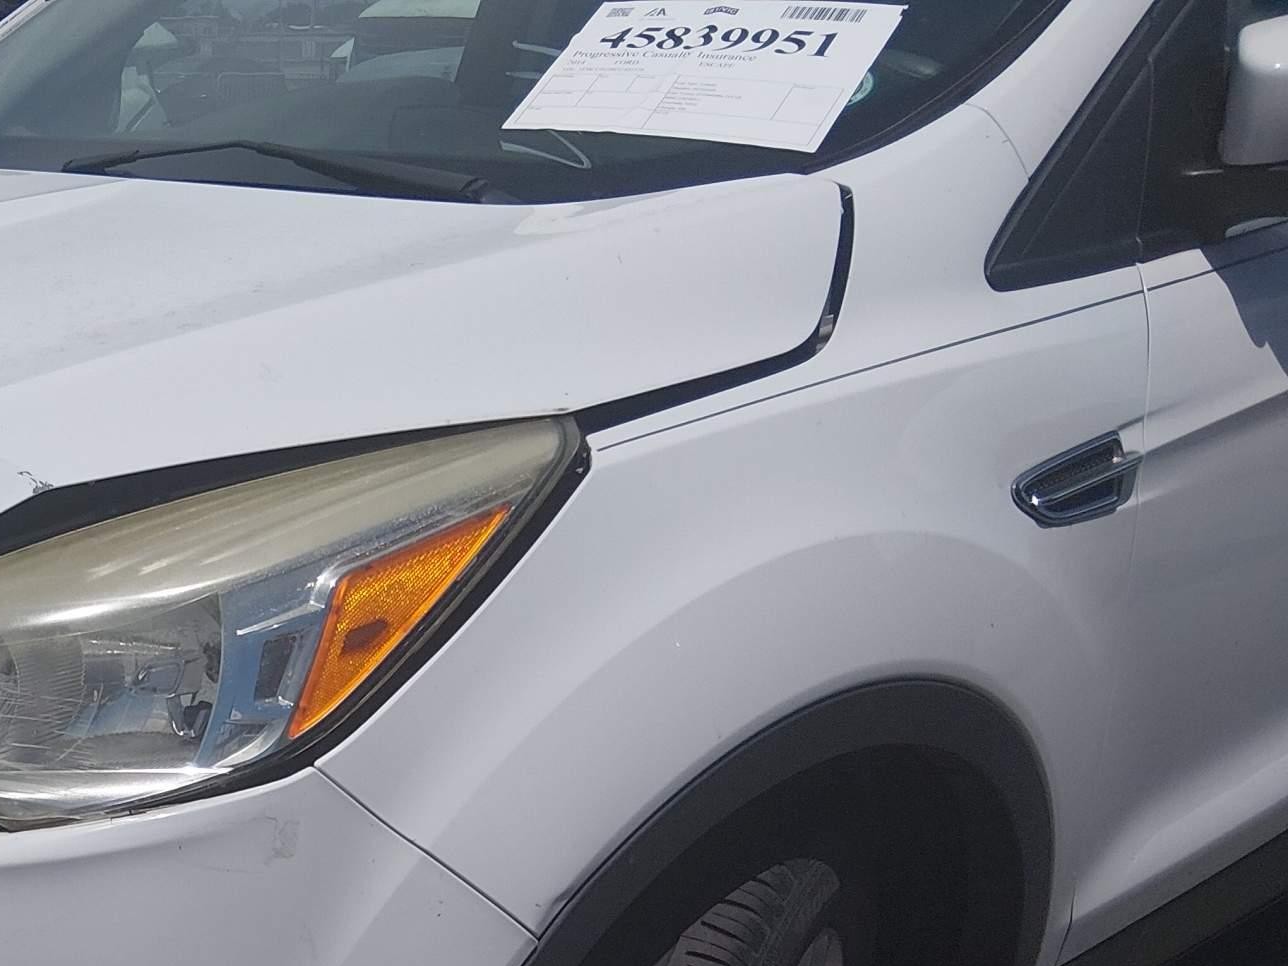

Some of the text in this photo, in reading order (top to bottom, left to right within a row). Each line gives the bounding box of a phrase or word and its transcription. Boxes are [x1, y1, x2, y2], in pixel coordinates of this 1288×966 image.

[599, 24, 839, 58] 45839951
[572, 50, 640, 59] Progressive
[696, 51, 758, 62] Insurance
